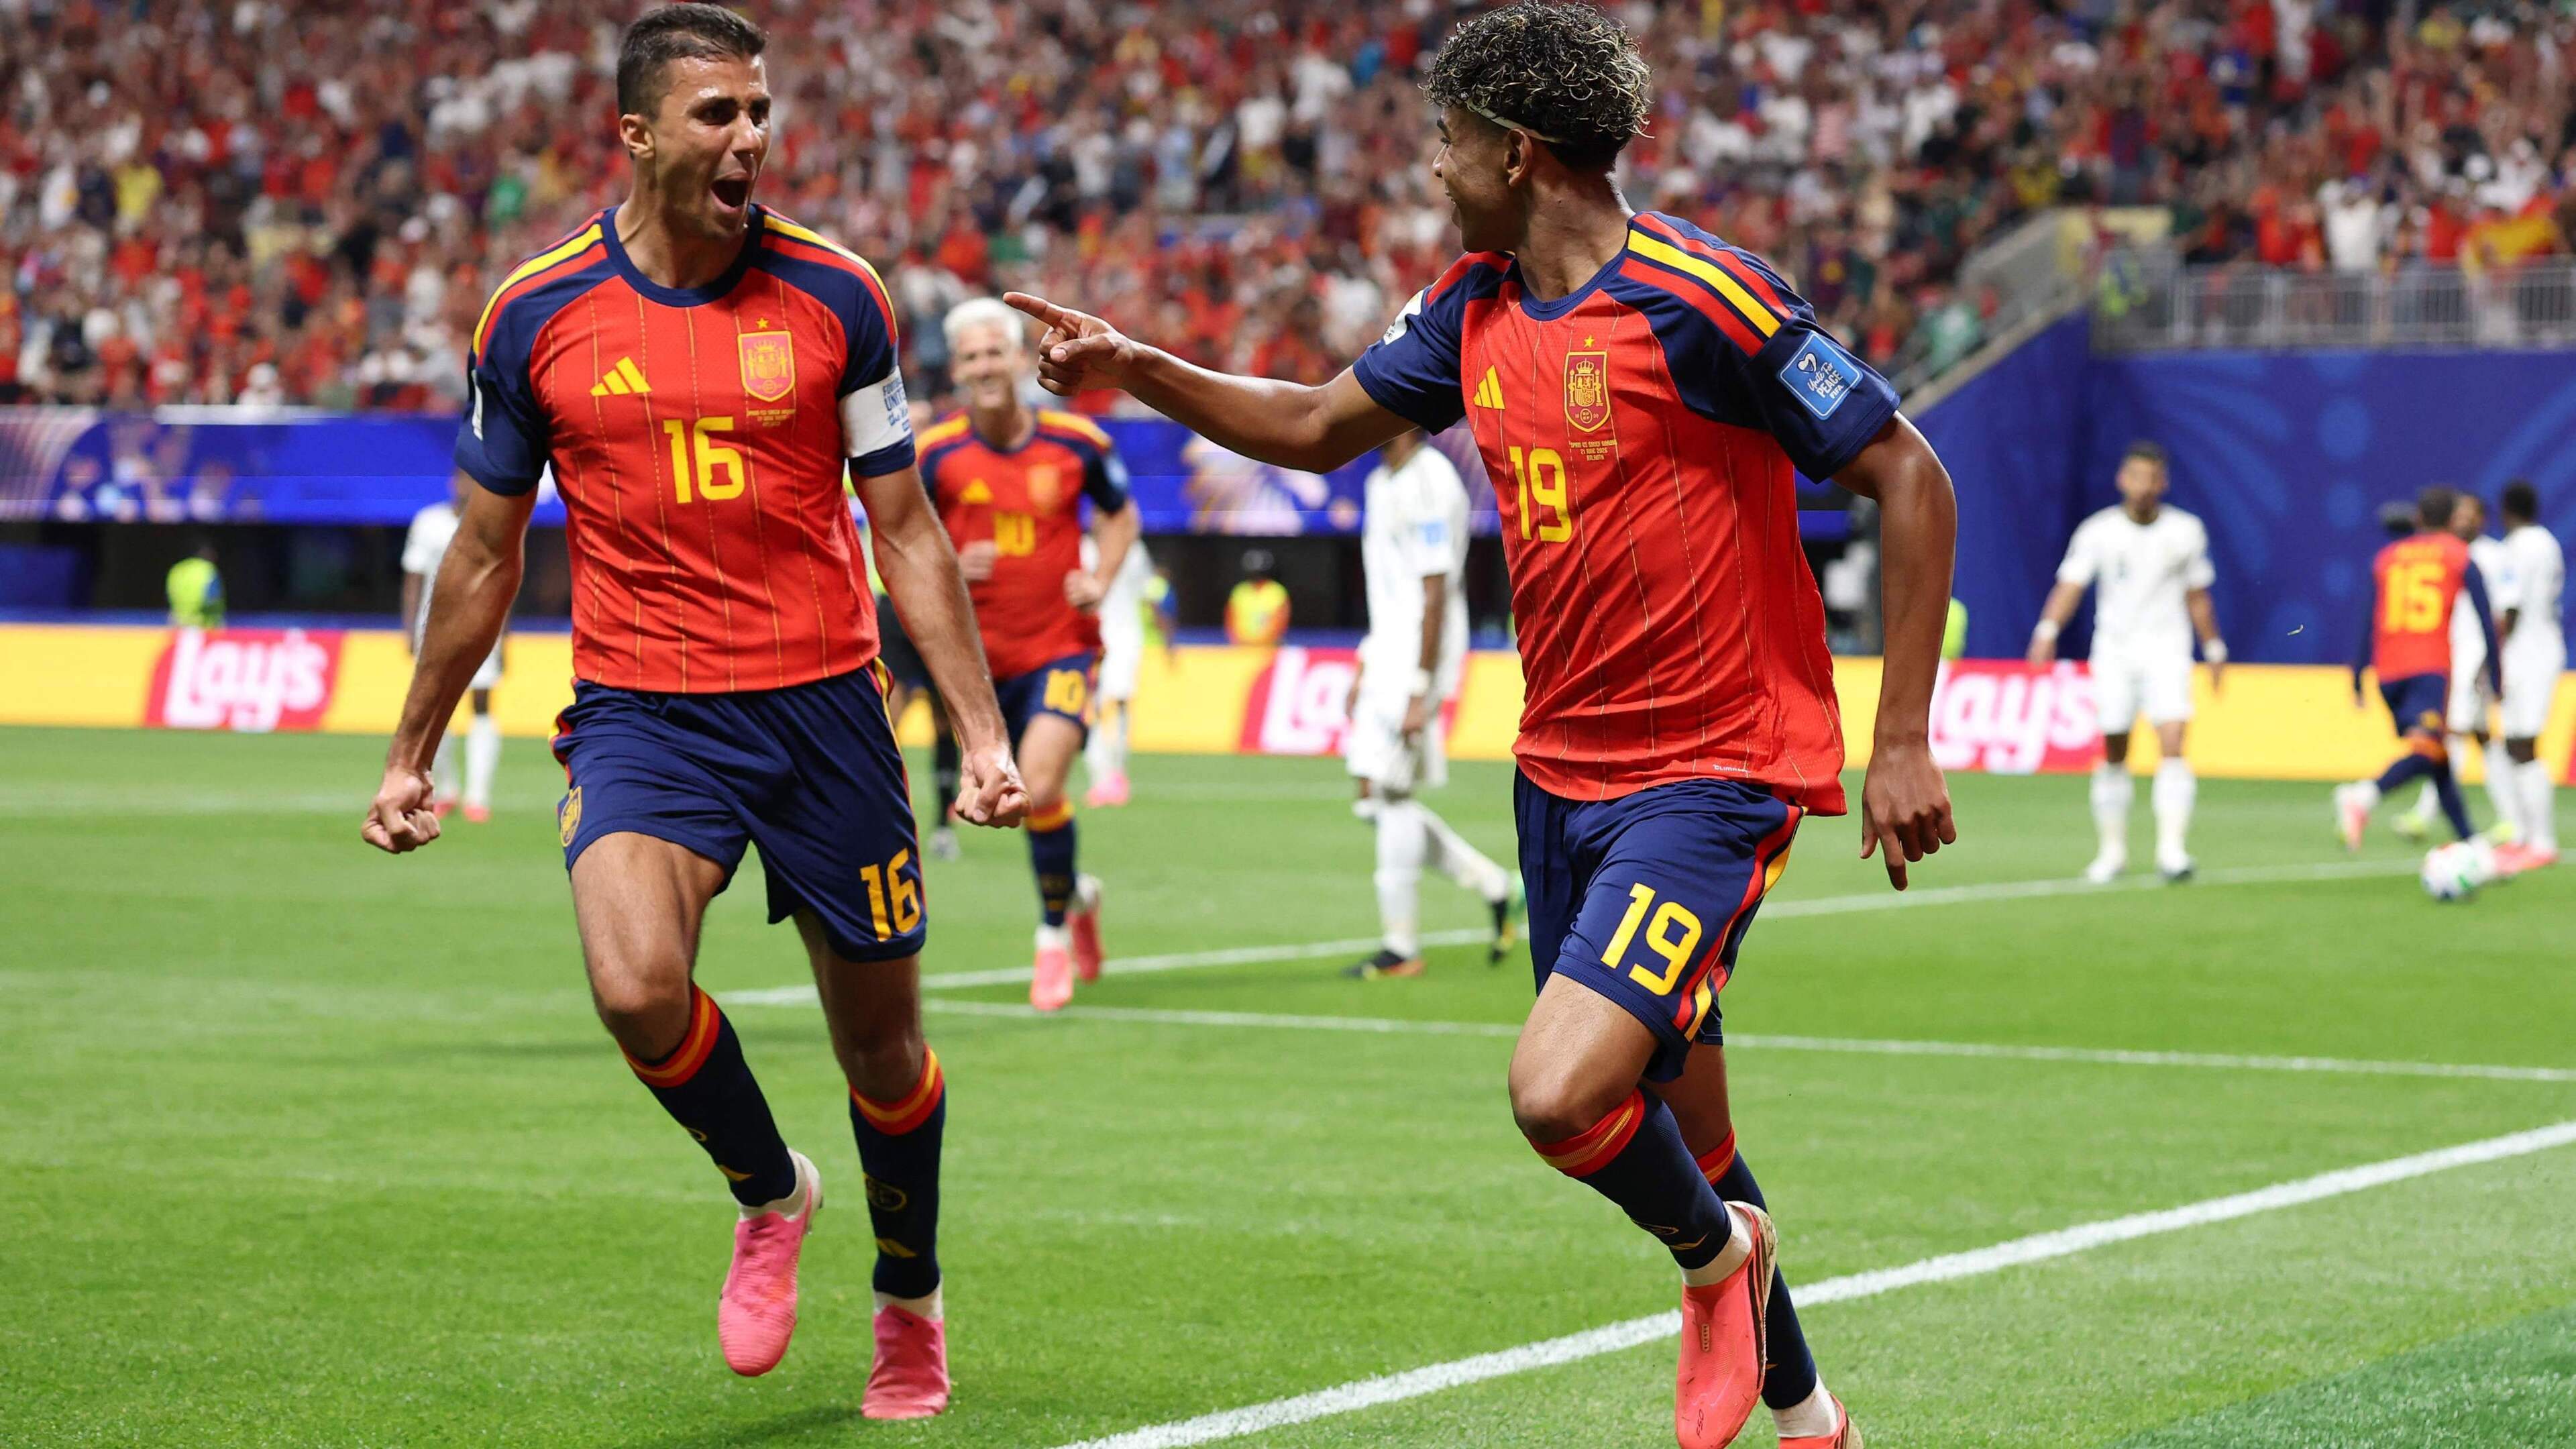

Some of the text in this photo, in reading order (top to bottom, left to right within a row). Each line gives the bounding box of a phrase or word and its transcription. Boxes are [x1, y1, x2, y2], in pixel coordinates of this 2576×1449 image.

[1807, 371, 1825, 391] Unite
[1816, 370, 1843, 398] PEACE
[1829, 384, 1845, 399] FIFA
[663, 416, 745, 504] 16
[1508, 446, 1572, 543] 19
[2385, 562, 2446, 634] 15
[163, 626, 328, 732] Lay's
[1044, 668, 1087, 715] 10
[859, 847, 920, 943] 16
[1601, 882, 1703, 996] 19
